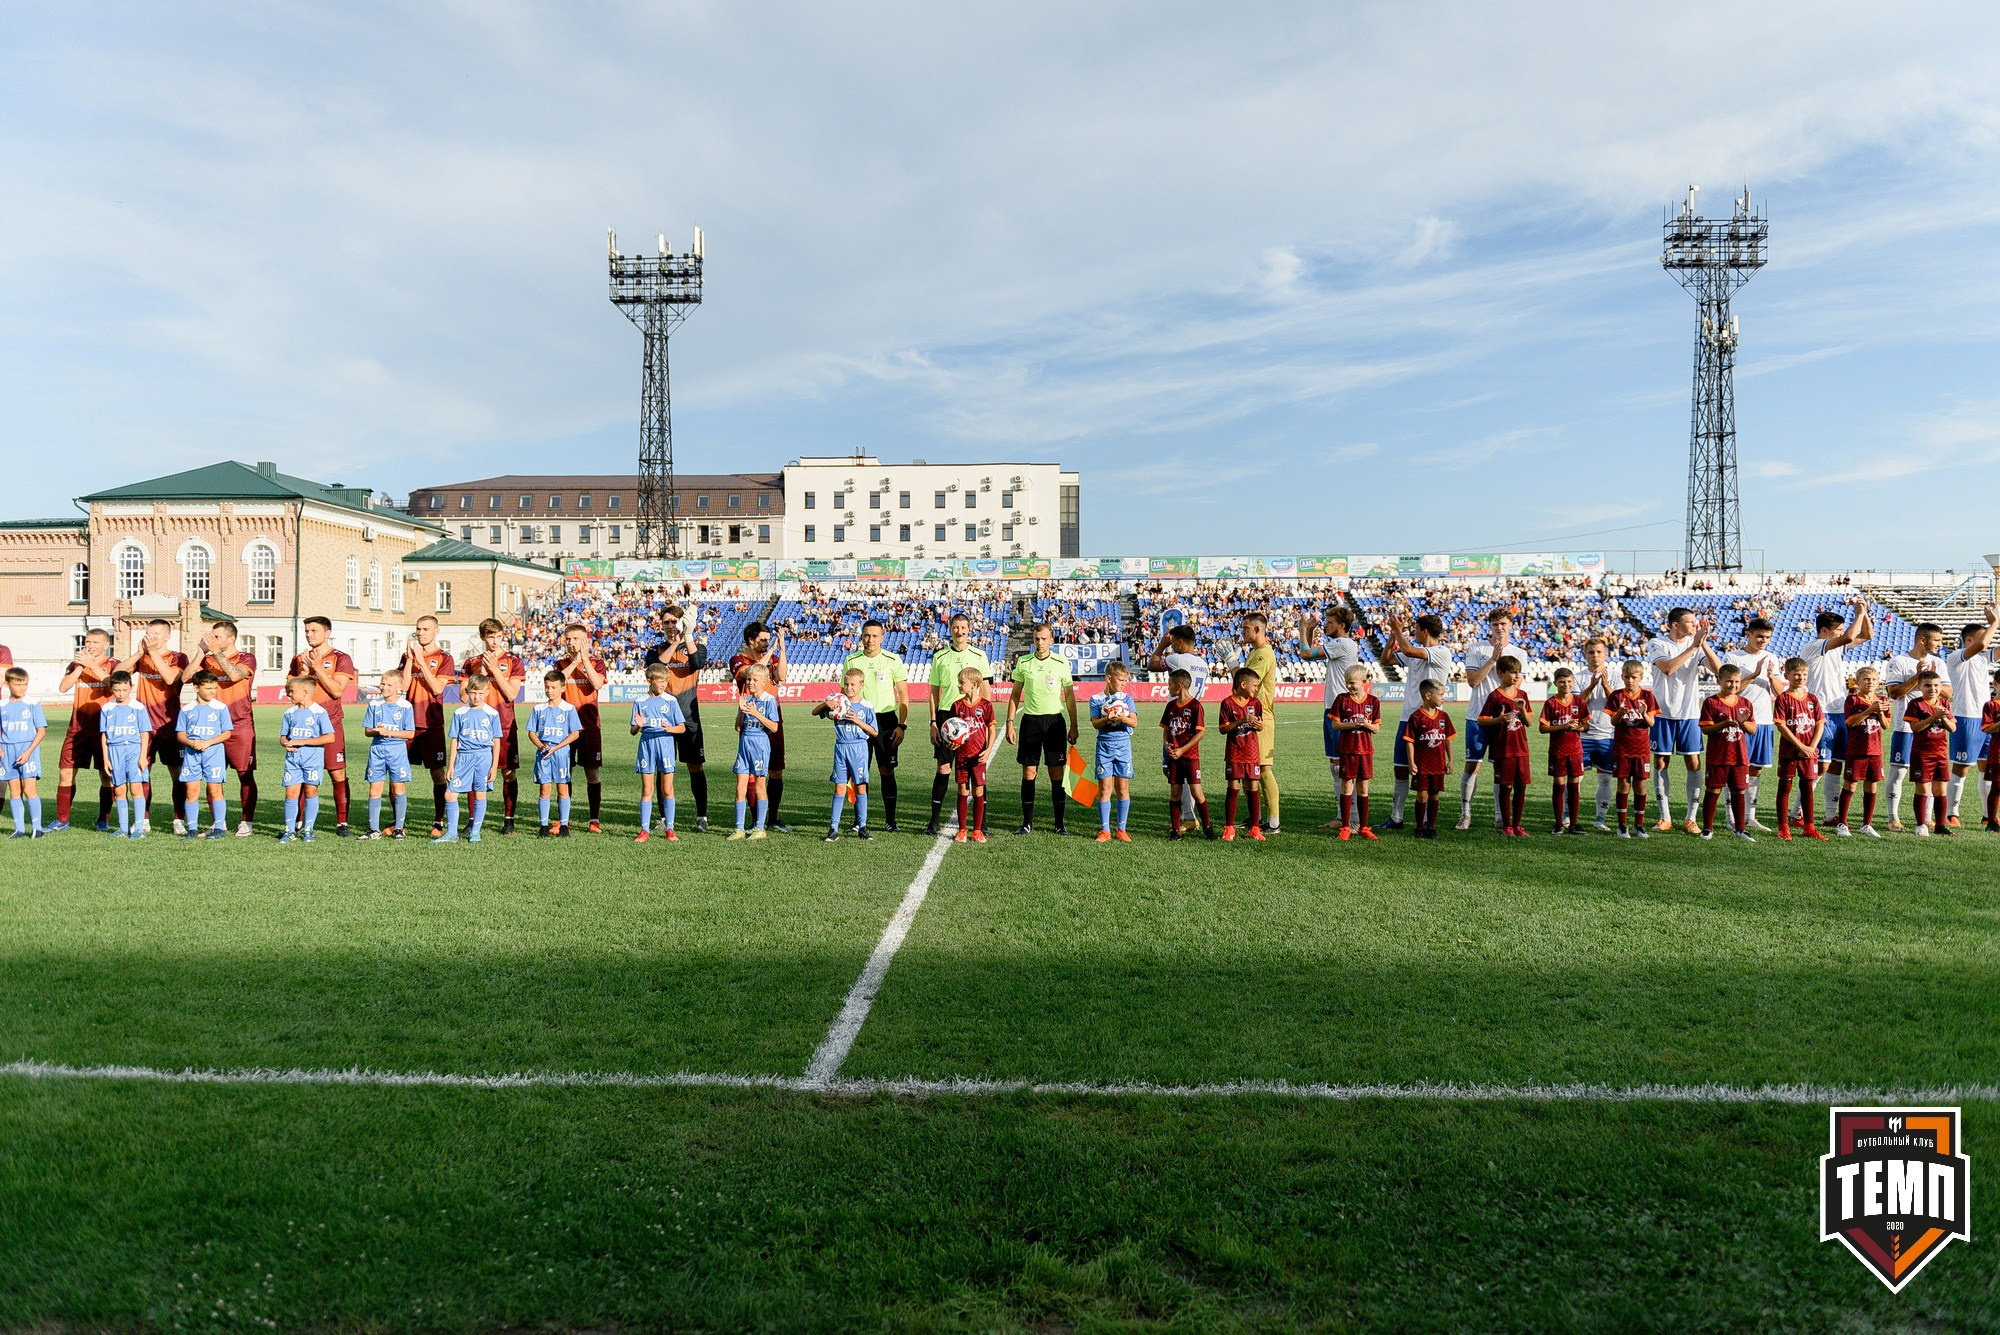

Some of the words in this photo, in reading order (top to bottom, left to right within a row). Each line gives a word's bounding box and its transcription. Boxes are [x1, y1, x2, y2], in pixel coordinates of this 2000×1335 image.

[778, 686, 805, 697] BET
[1274, 686, 1313, 698] NBET
[8, 722, 28, 731] ВТБ
[114, 726, 136, 736] ВТБ
[193, 726, 214, 736] ВТБ
[544, 726, 563, 736] ВТБ
[292, 728, 312, 736] ВТБ
[1894, 752, 1900, 762] 8
[1956, 752, 1968, 760] 49
[24, 762, 36, 773] 16
[754, 760, 764, 771] 21
[211, 766, 222, 778] 17
[308, 770, 318, 781] 18
[400, 768, 406, 778] 5
[858, 768, 864, 778] 3
